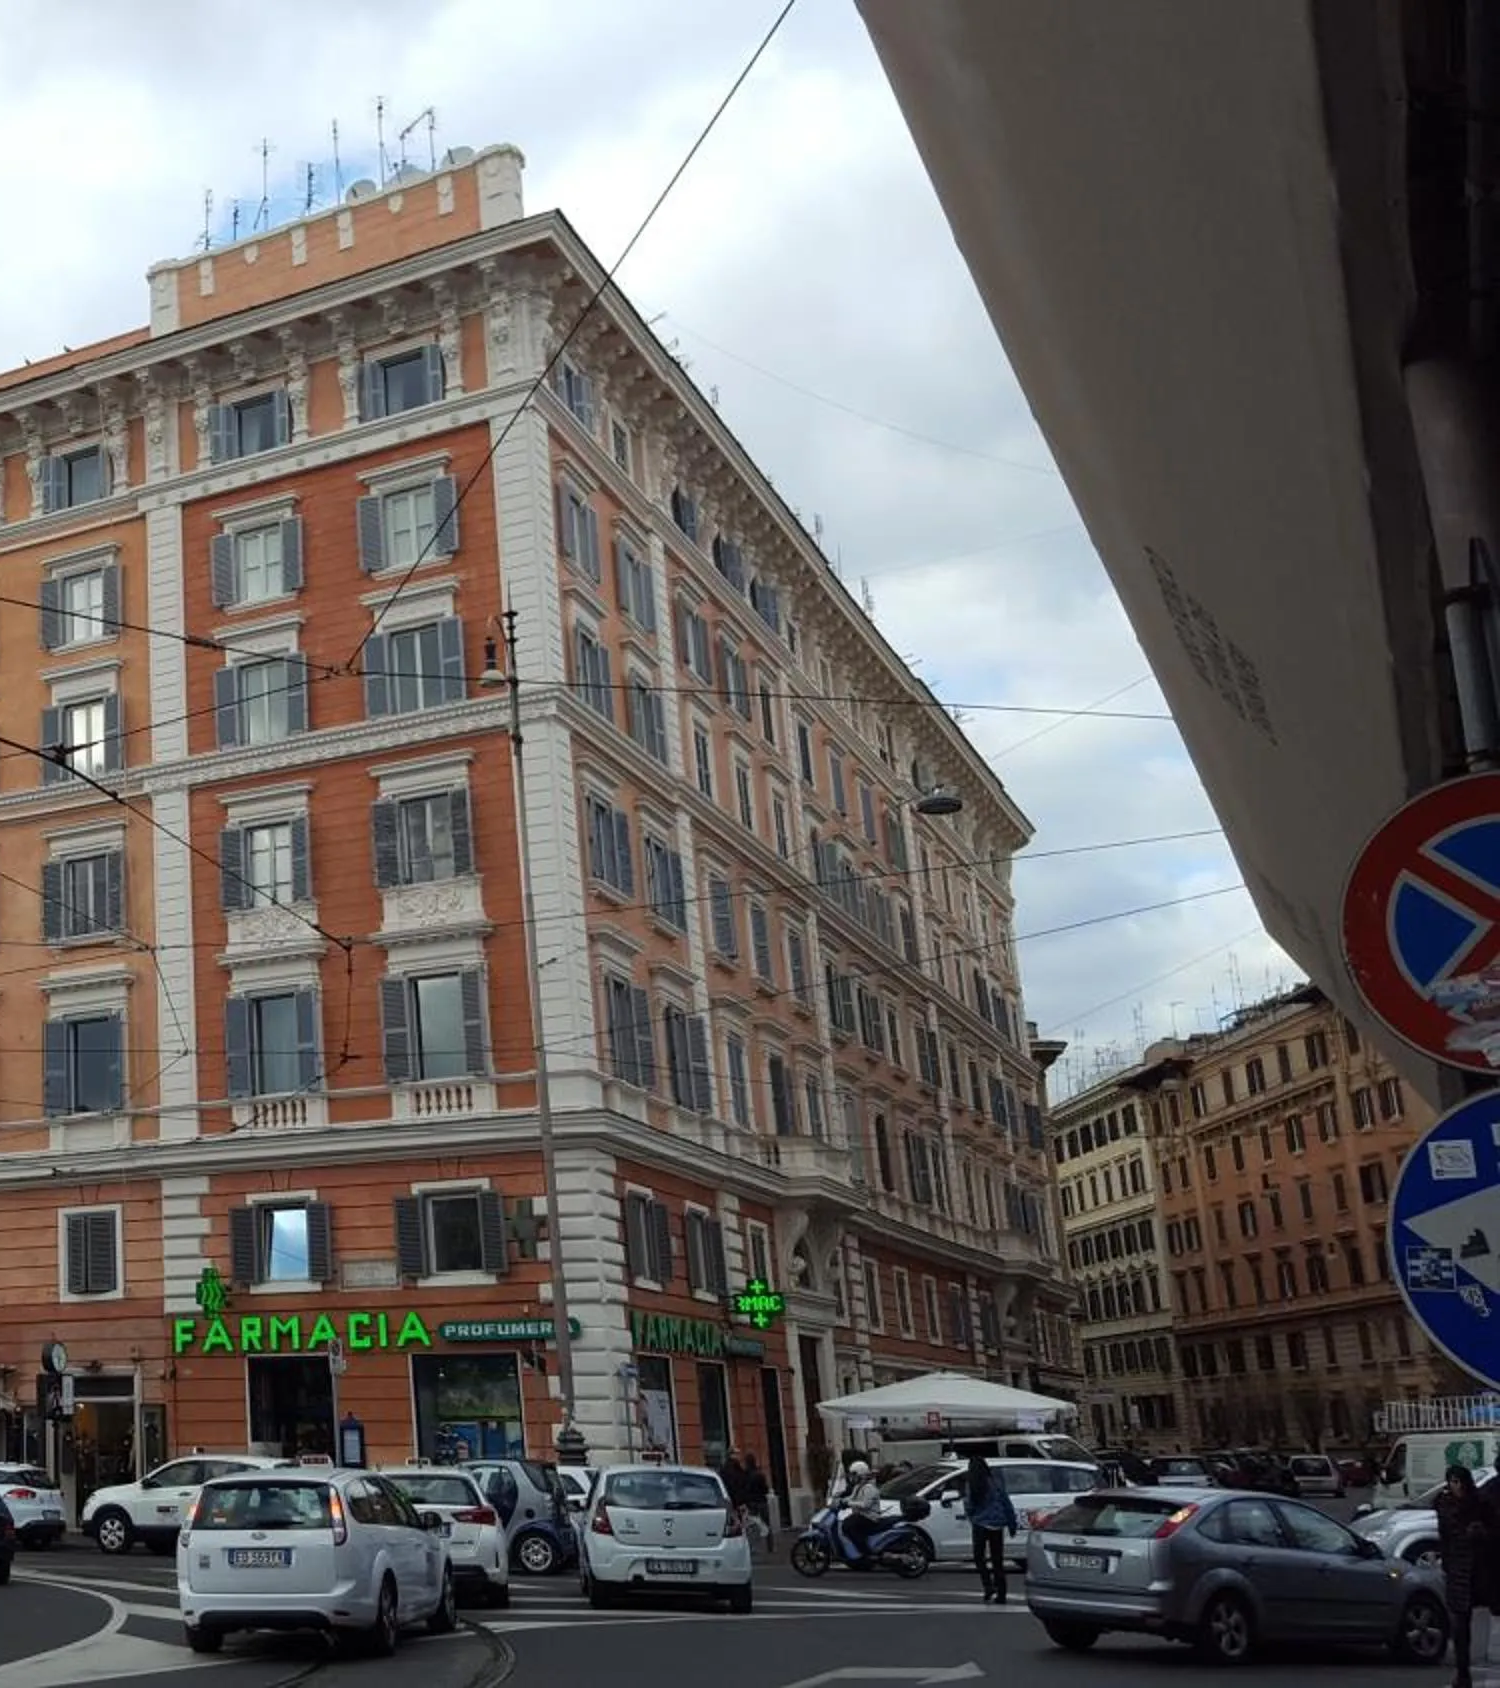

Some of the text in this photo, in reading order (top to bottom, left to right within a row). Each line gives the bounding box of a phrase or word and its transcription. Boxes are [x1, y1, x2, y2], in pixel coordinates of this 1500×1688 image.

[174, 1310, 432, 1354] FARMACIA
[444, 1322, 574, 1337] PROFUMER
[632, 1310, 725, 1357] FARMACIA
